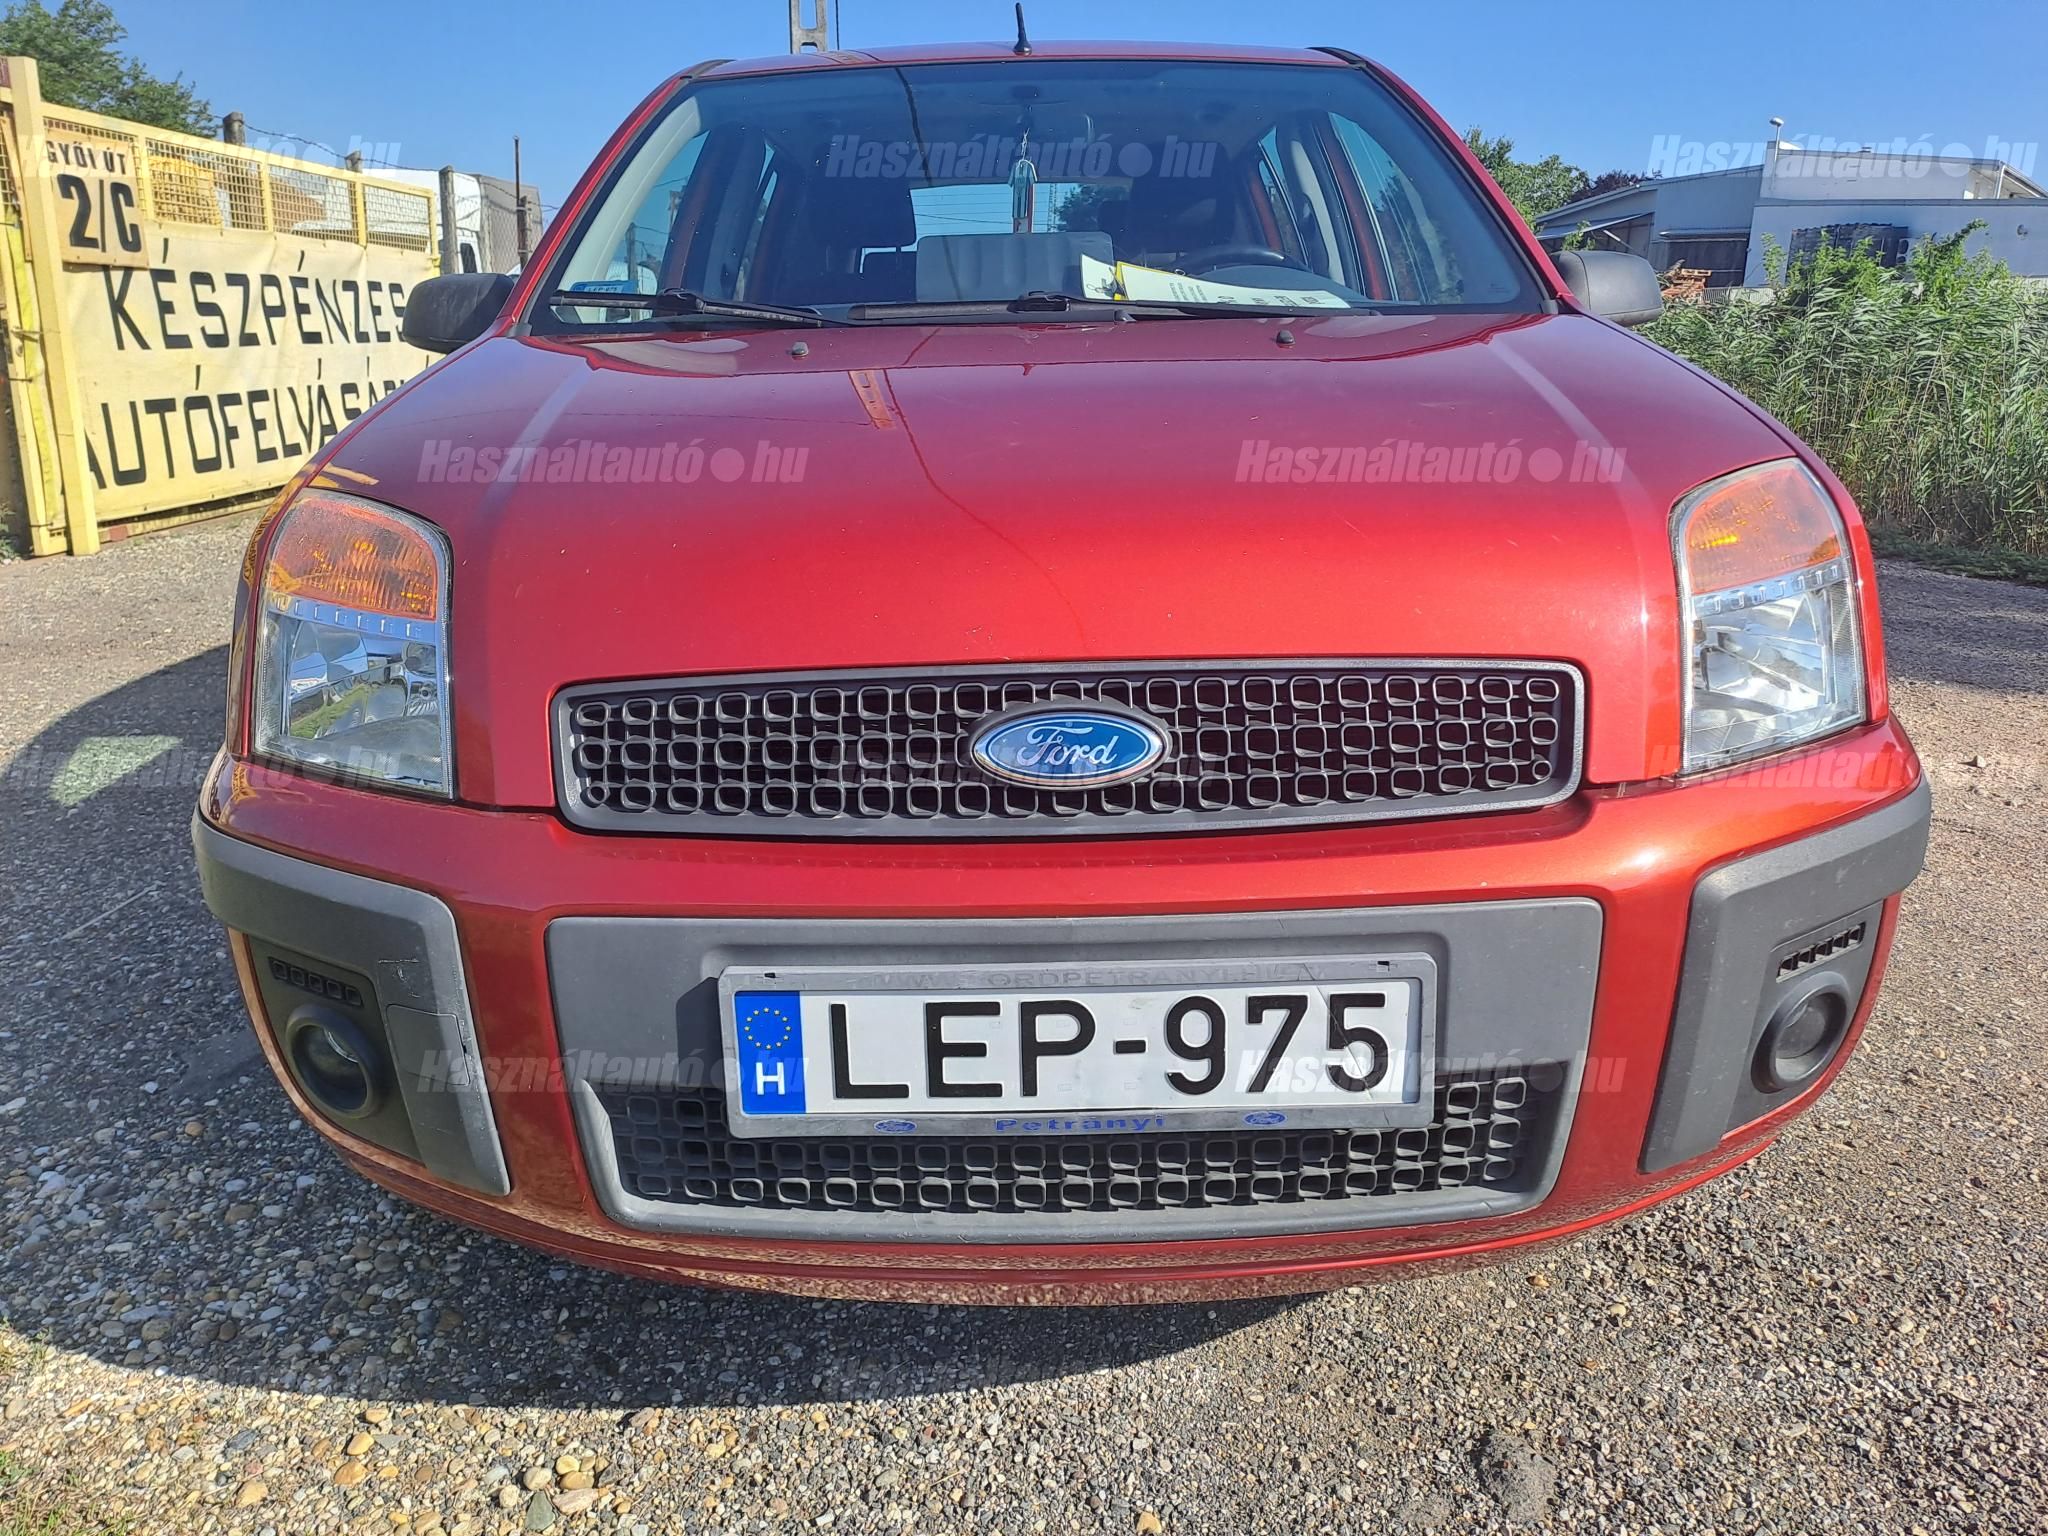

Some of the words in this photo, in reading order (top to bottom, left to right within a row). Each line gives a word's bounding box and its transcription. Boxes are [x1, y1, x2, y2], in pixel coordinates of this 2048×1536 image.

[103, 147, 126, 175] ÚT
[57, 174, 142, 253] 2/C
[1016, 726, 1119, 766] Ford
[829, 993, 1388, 1100] LEP-975
[755, 1062, 785, 1096] H
